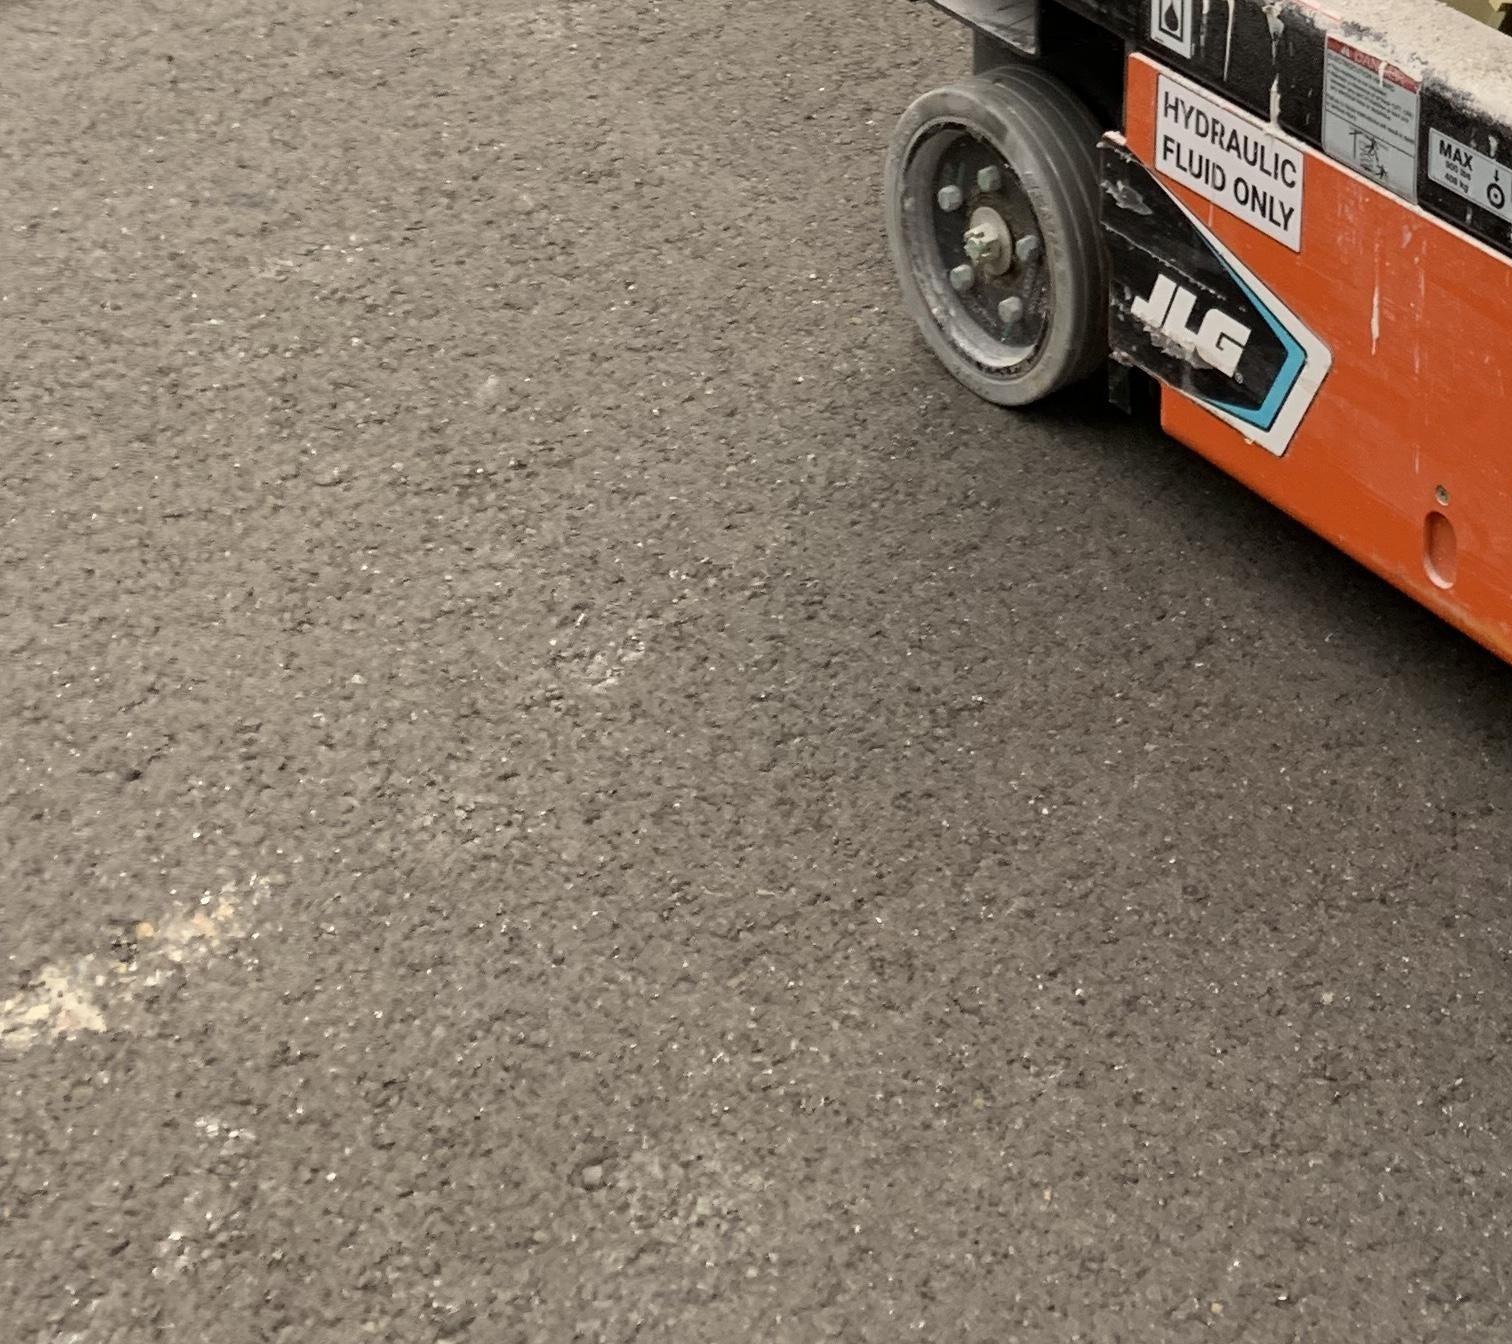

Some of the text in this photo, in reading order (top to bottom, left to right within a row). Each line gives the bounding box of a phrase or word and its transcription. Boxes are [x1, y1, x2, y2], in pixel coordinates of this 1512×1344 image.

[1163, 90, 1297, 189] HYDRAULIC
[1163, 134, 1295, 232] FLUID ONLY
[1439, 139, 1473, 171] MAX
[1131, 273, 1252, 379] JLG
